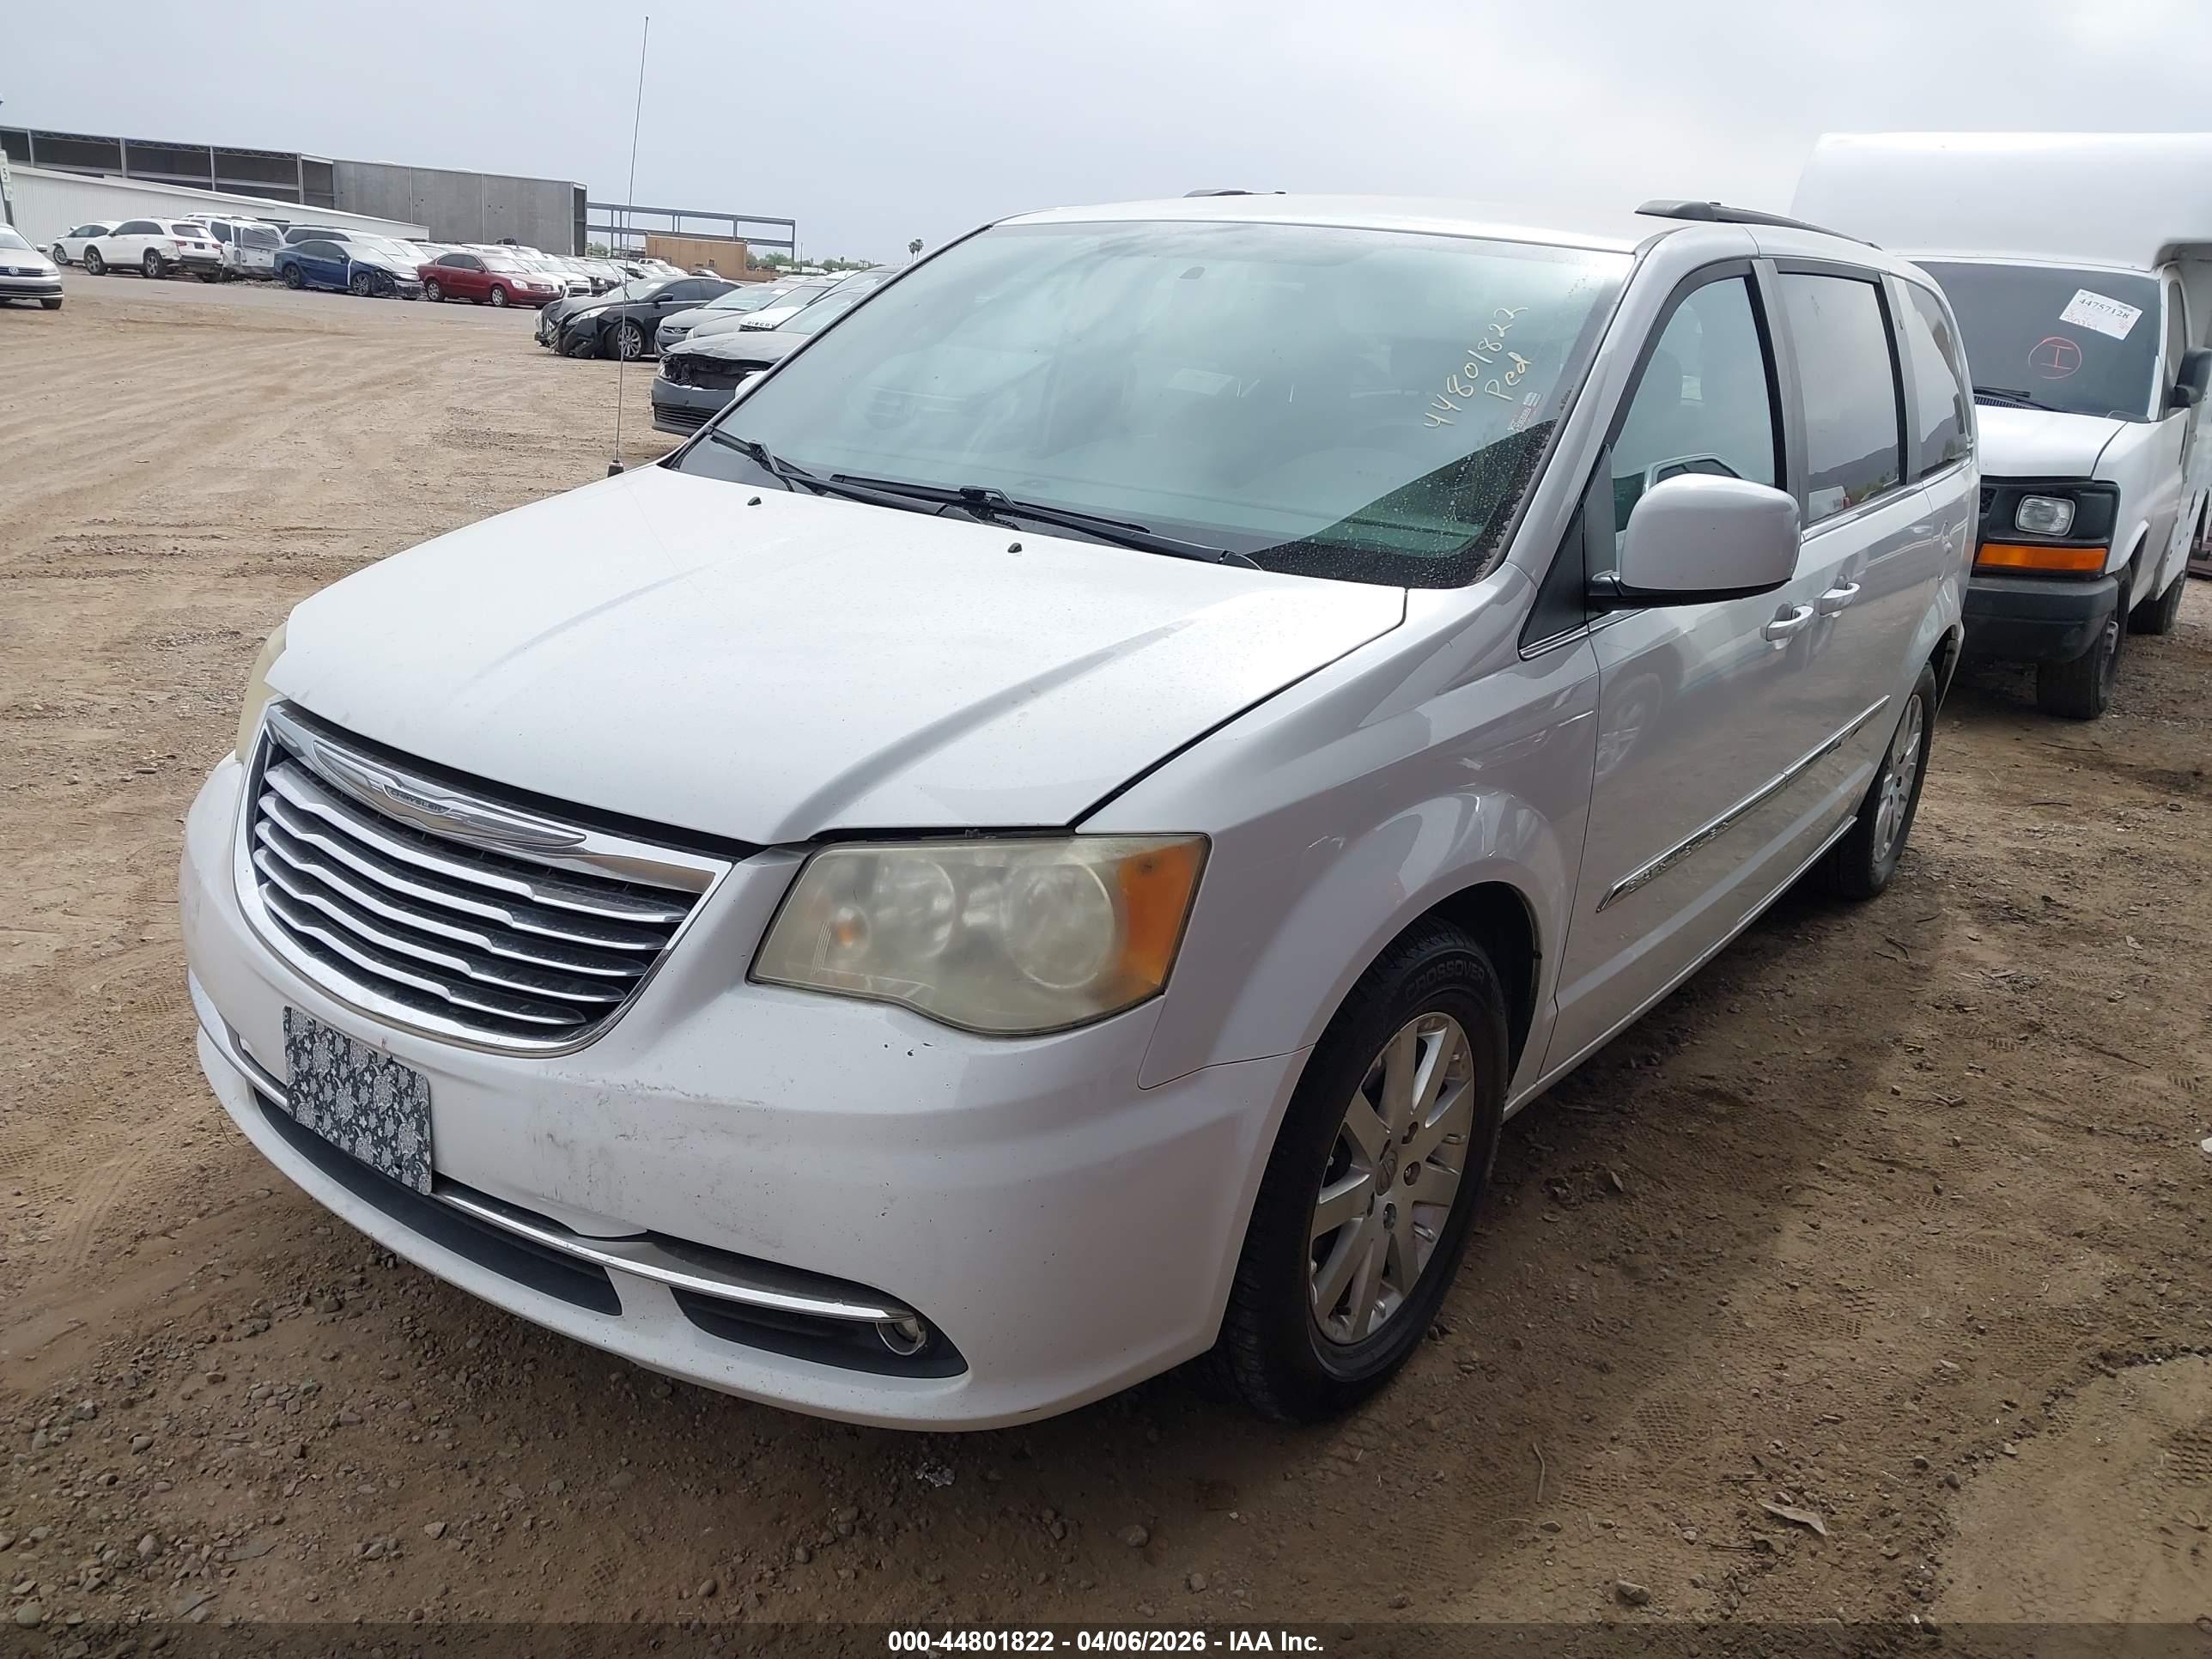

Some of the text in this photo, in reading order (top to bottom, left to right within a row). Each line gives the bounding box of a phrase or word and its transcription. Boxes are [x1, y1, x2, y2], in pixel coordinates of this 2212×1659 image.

[2080, 299, 2130, 319] 44757128
[1423, 307, 1528, 428] 44801822
[392, 790, 442, 812] CHRYSLER
